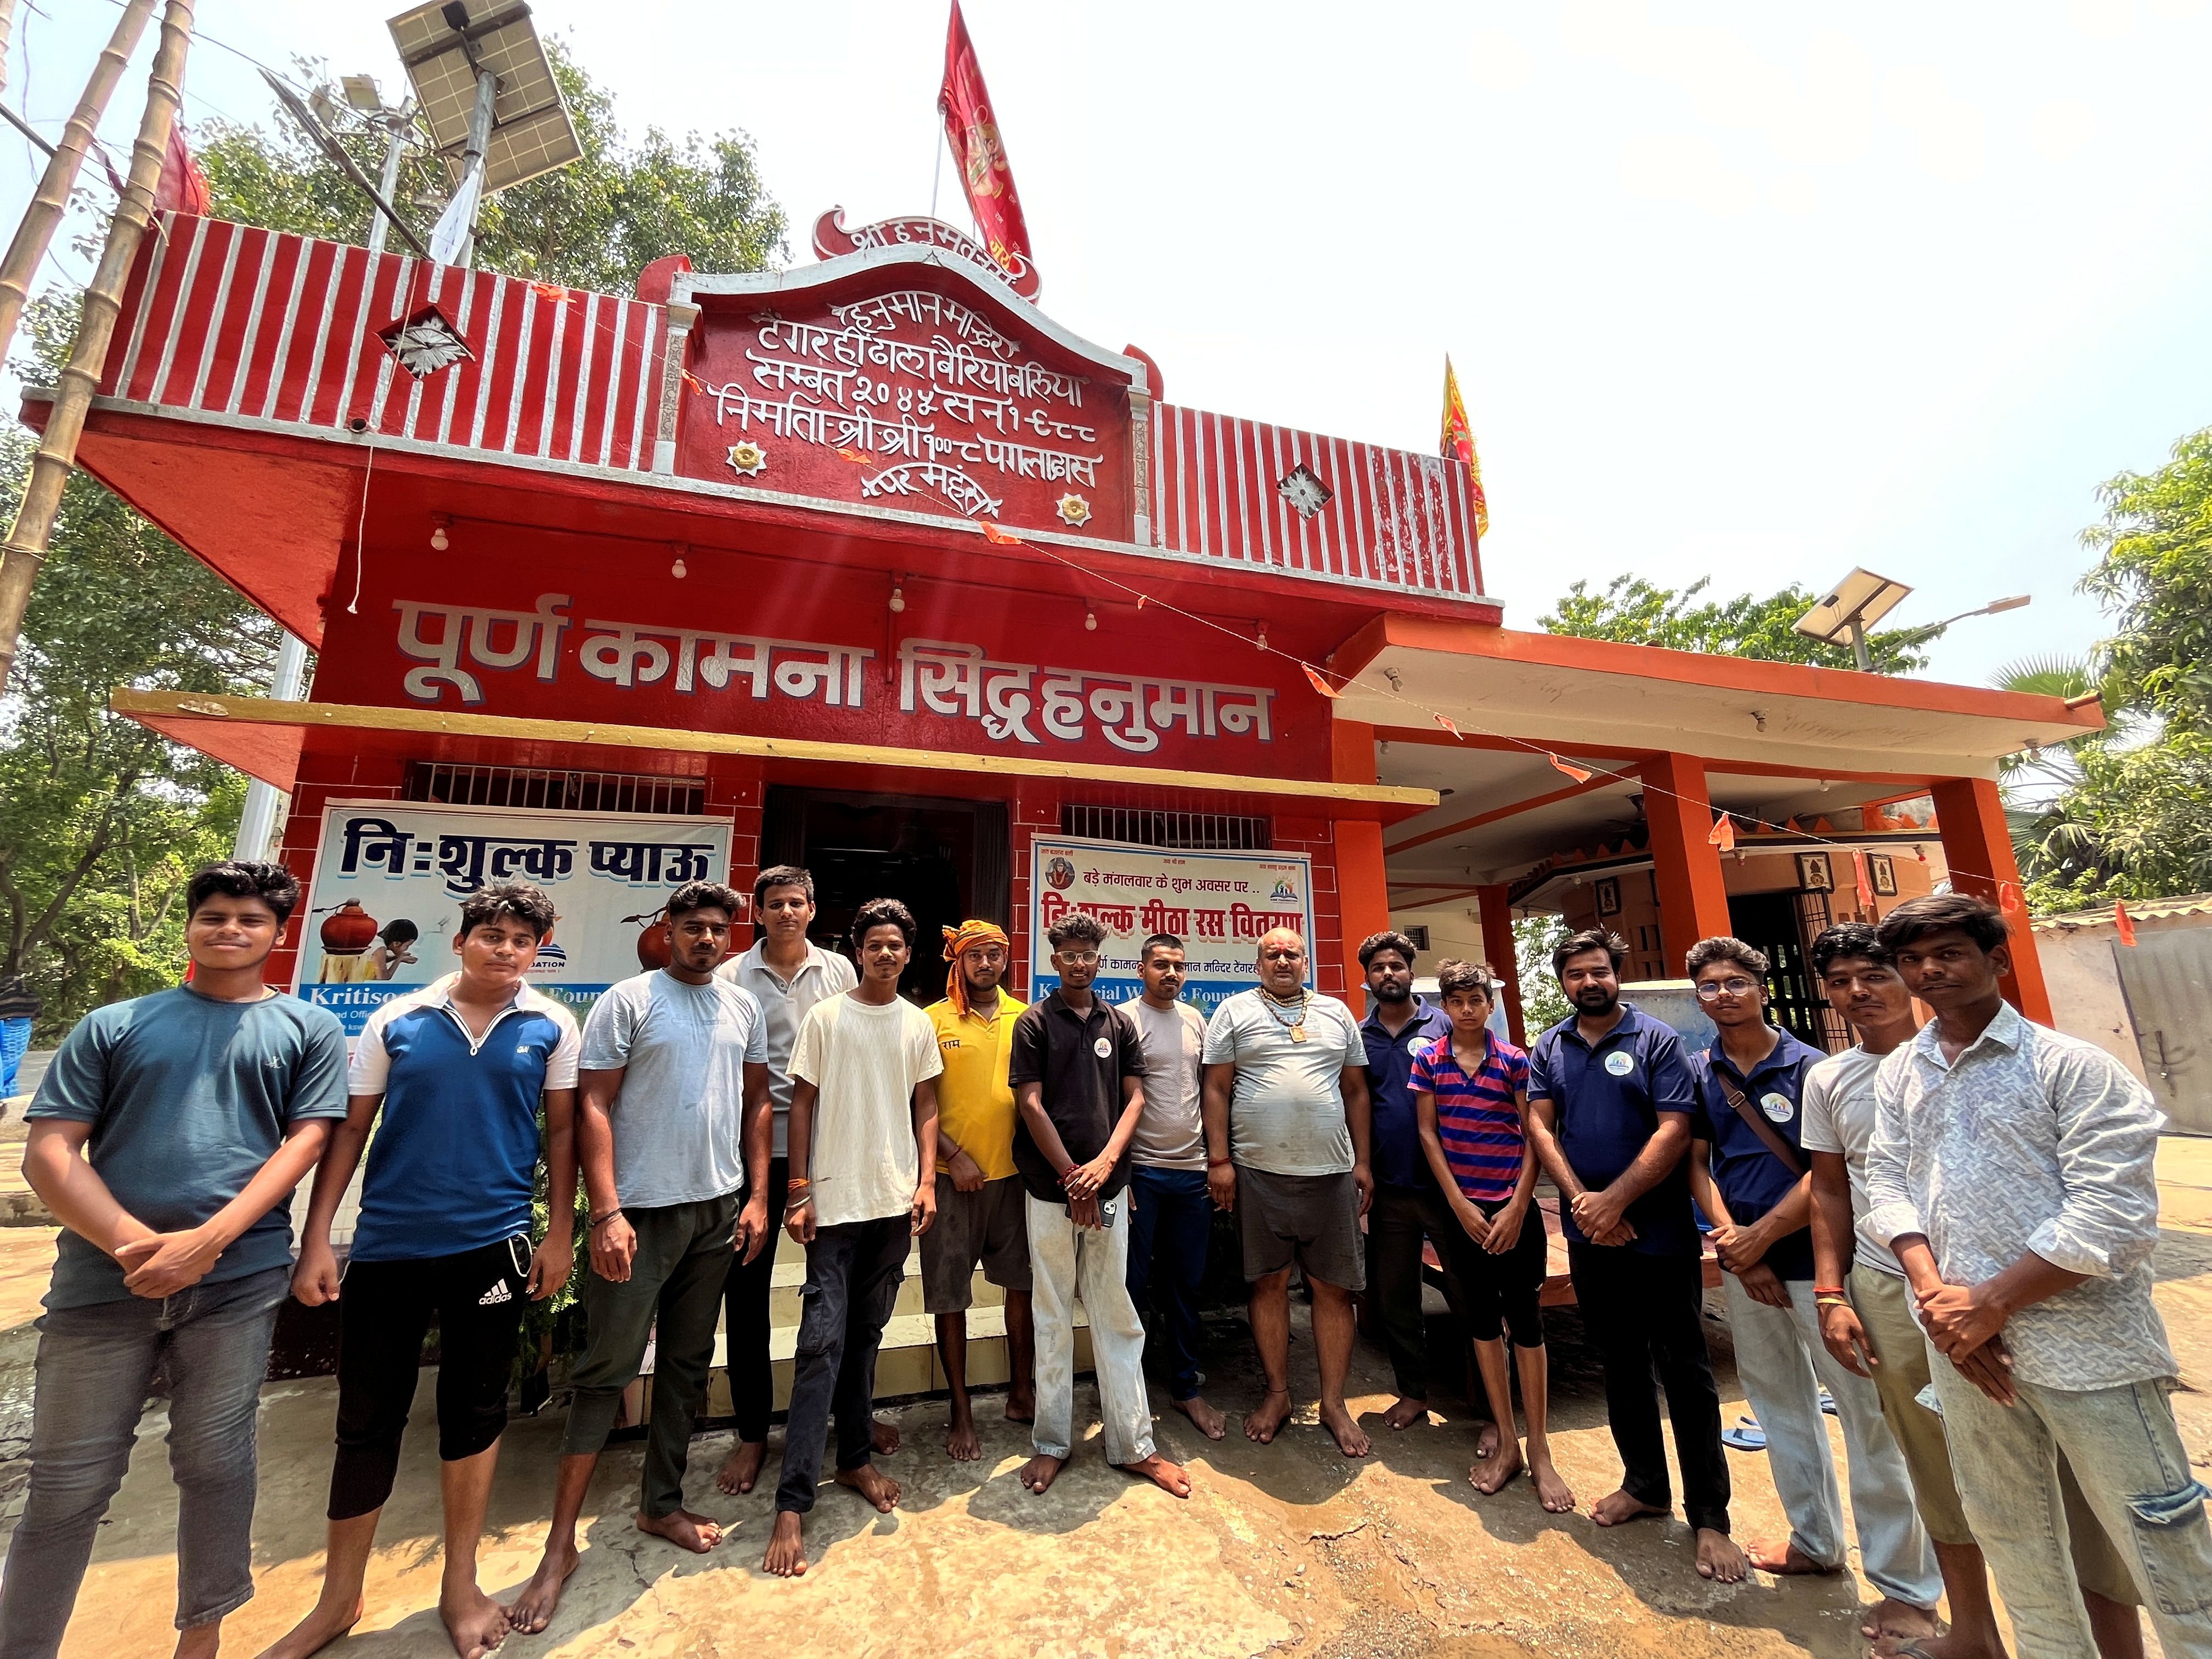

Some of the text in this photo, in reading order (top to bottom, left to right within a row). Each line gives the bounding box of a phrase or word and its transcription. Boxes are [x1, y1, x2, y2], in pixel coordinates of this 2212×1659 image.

[839, 291, 944, 334] हनुमान
[1008, 361, 1091, 408] बलिया
[392, 594, 569, 701] पूर्ण
[578, 618, 874, 707] कामना
[1042, 665, 1274, 752] हनुमान
[589, 840, 715, 881] प्याऊ
[1083, 868, 1100, 887] बड़े
[1103, 872, 1152, 888] मंगलवार
[1155, 873, 1168, 888] के
[1172, 877, 1192, 893] शुभ
[1195, 879, 1231, 892] अवसर
[1234, 881, 1249, 893] पर
[1139, 899, 1190, 936] मीठा
[1194, 909, 1226, 936] रस
[1110, 959, 1142, 970] कामन
[1204, 960, 1231, 973] मन्दिर
[941, 1040, 960, 1050] राम
[479, 1293, 512, 1305] adidas
